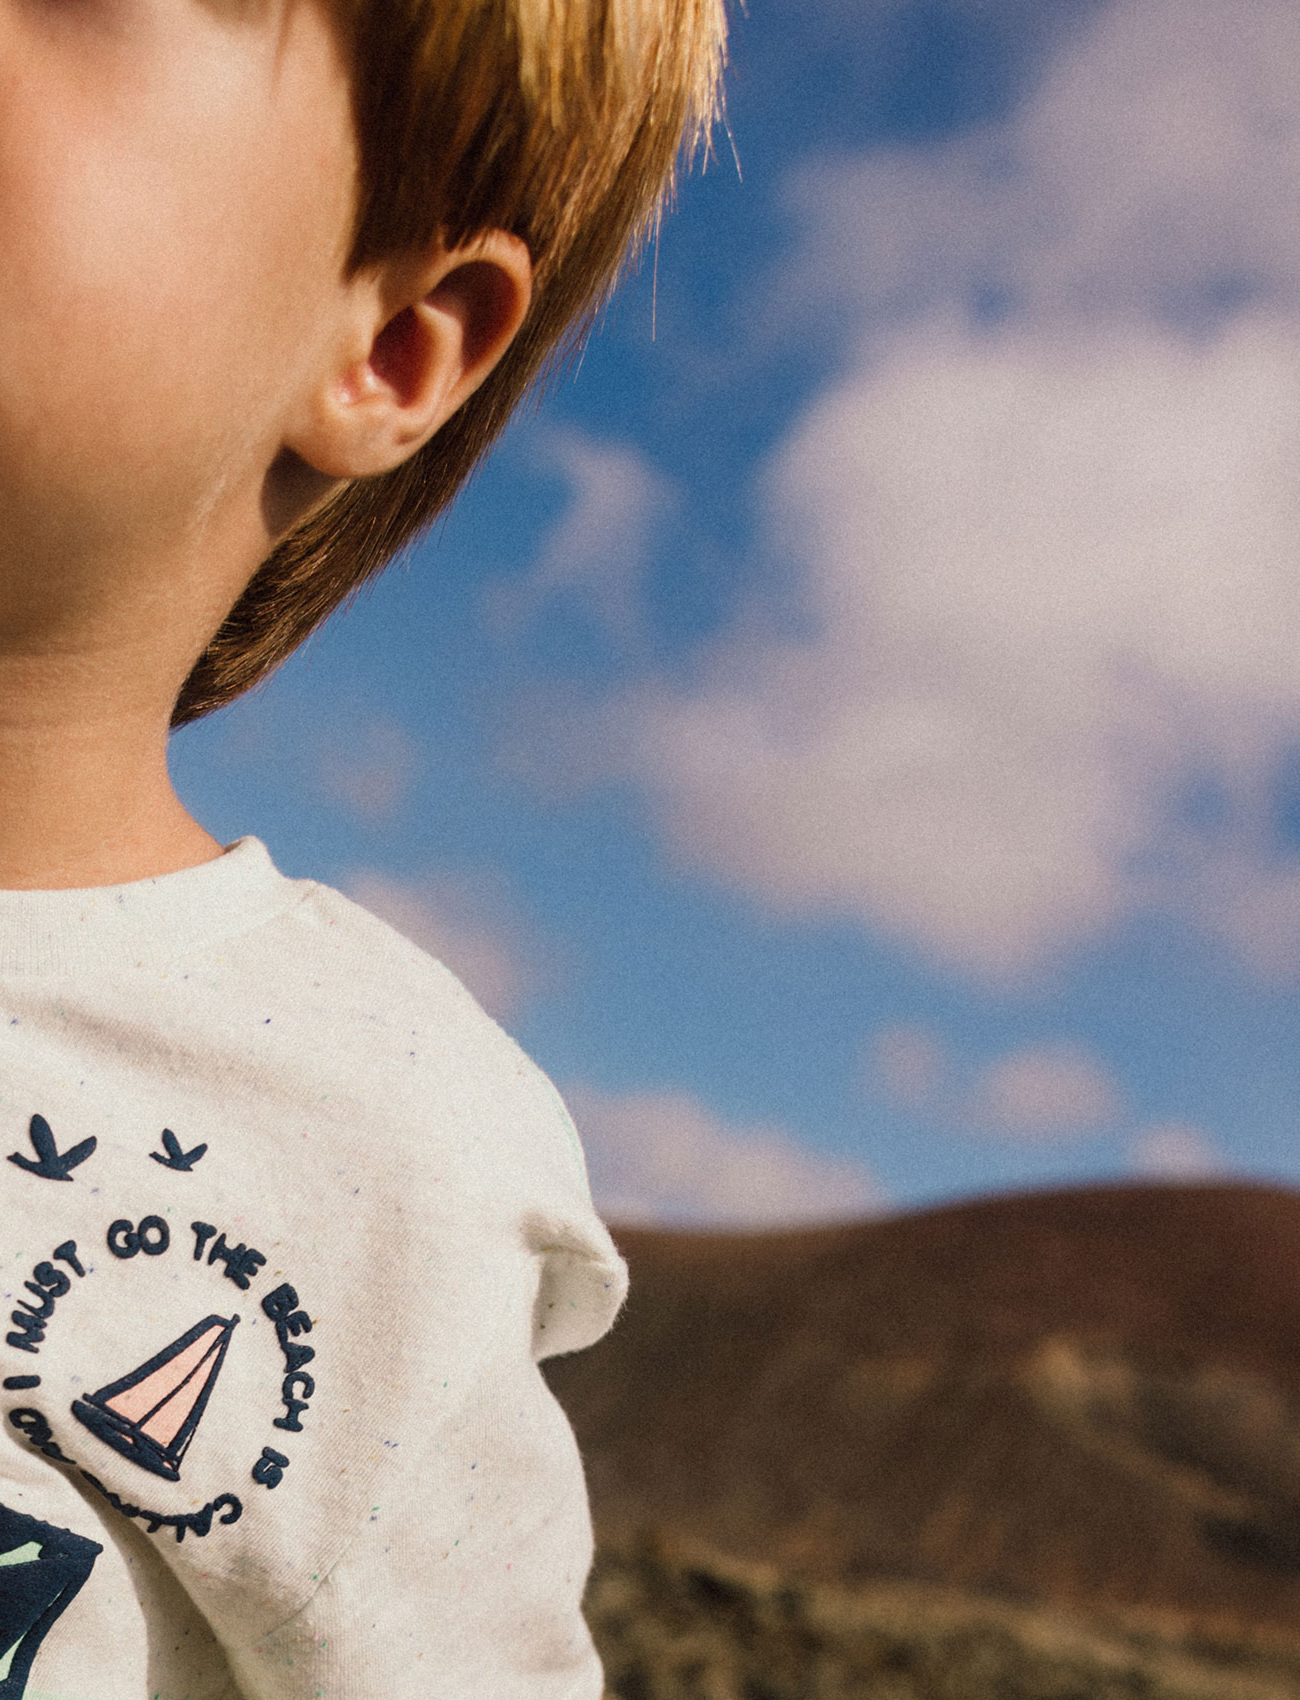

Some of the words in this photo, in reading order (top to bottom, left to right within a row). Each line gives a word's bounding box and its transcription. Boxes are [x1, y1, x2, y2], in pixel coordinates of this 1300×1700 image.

[107, 1215, 170, 1259] GO
[191, 1221, 267, 1290] THE
[6, 1240, 86, 1353] MUST
[3, 1375, 41, 1390] I
[261, 1283, 315, 1432] BEACH
[252, 1447, 290, 1489] IS
